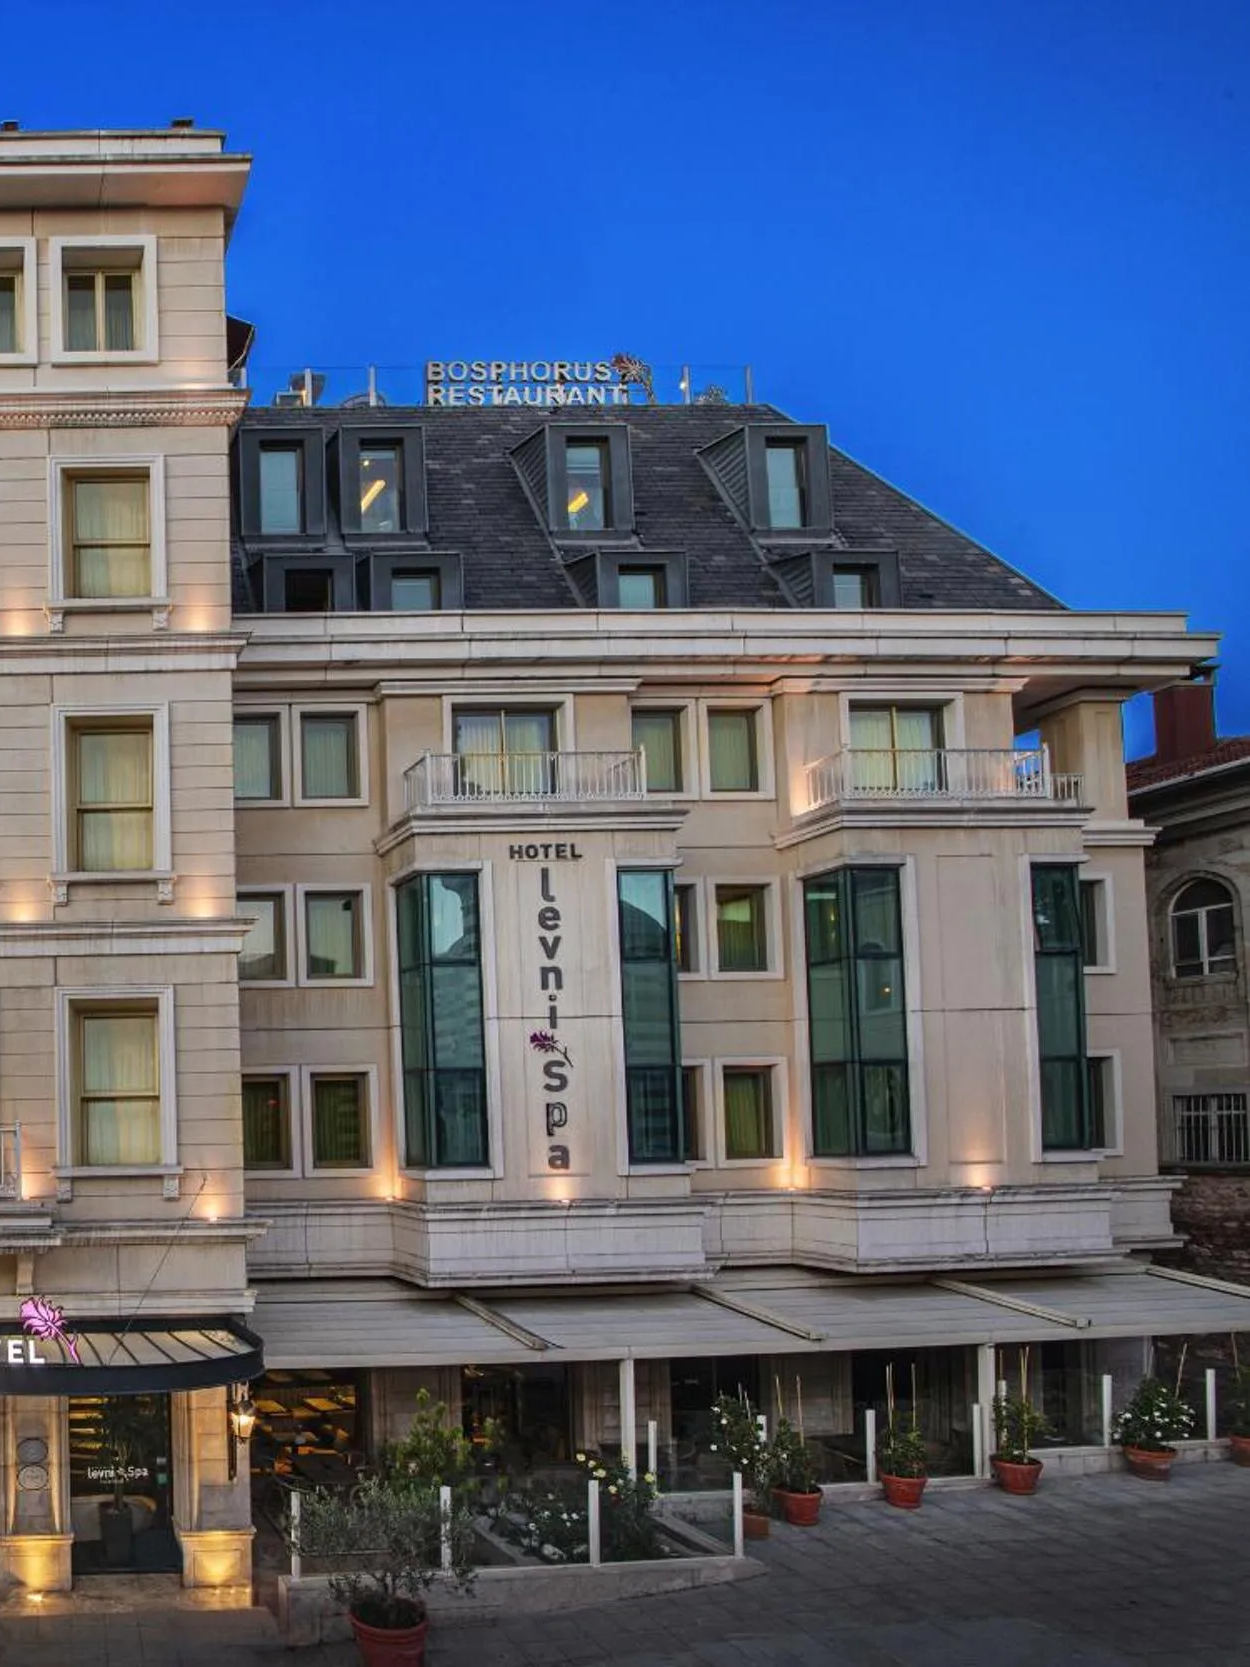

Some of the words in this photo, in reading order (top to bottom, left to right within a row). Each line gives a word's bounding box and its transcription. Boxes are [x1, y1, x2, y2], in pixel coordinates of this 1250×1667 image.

[427, 360, 612, 382] BOSPHORUS
[427, 383, 630, 406] RESTAURANT
[509, 843, 583, 860] HOTEL
[543, 1060, 570, 1171] Spa
